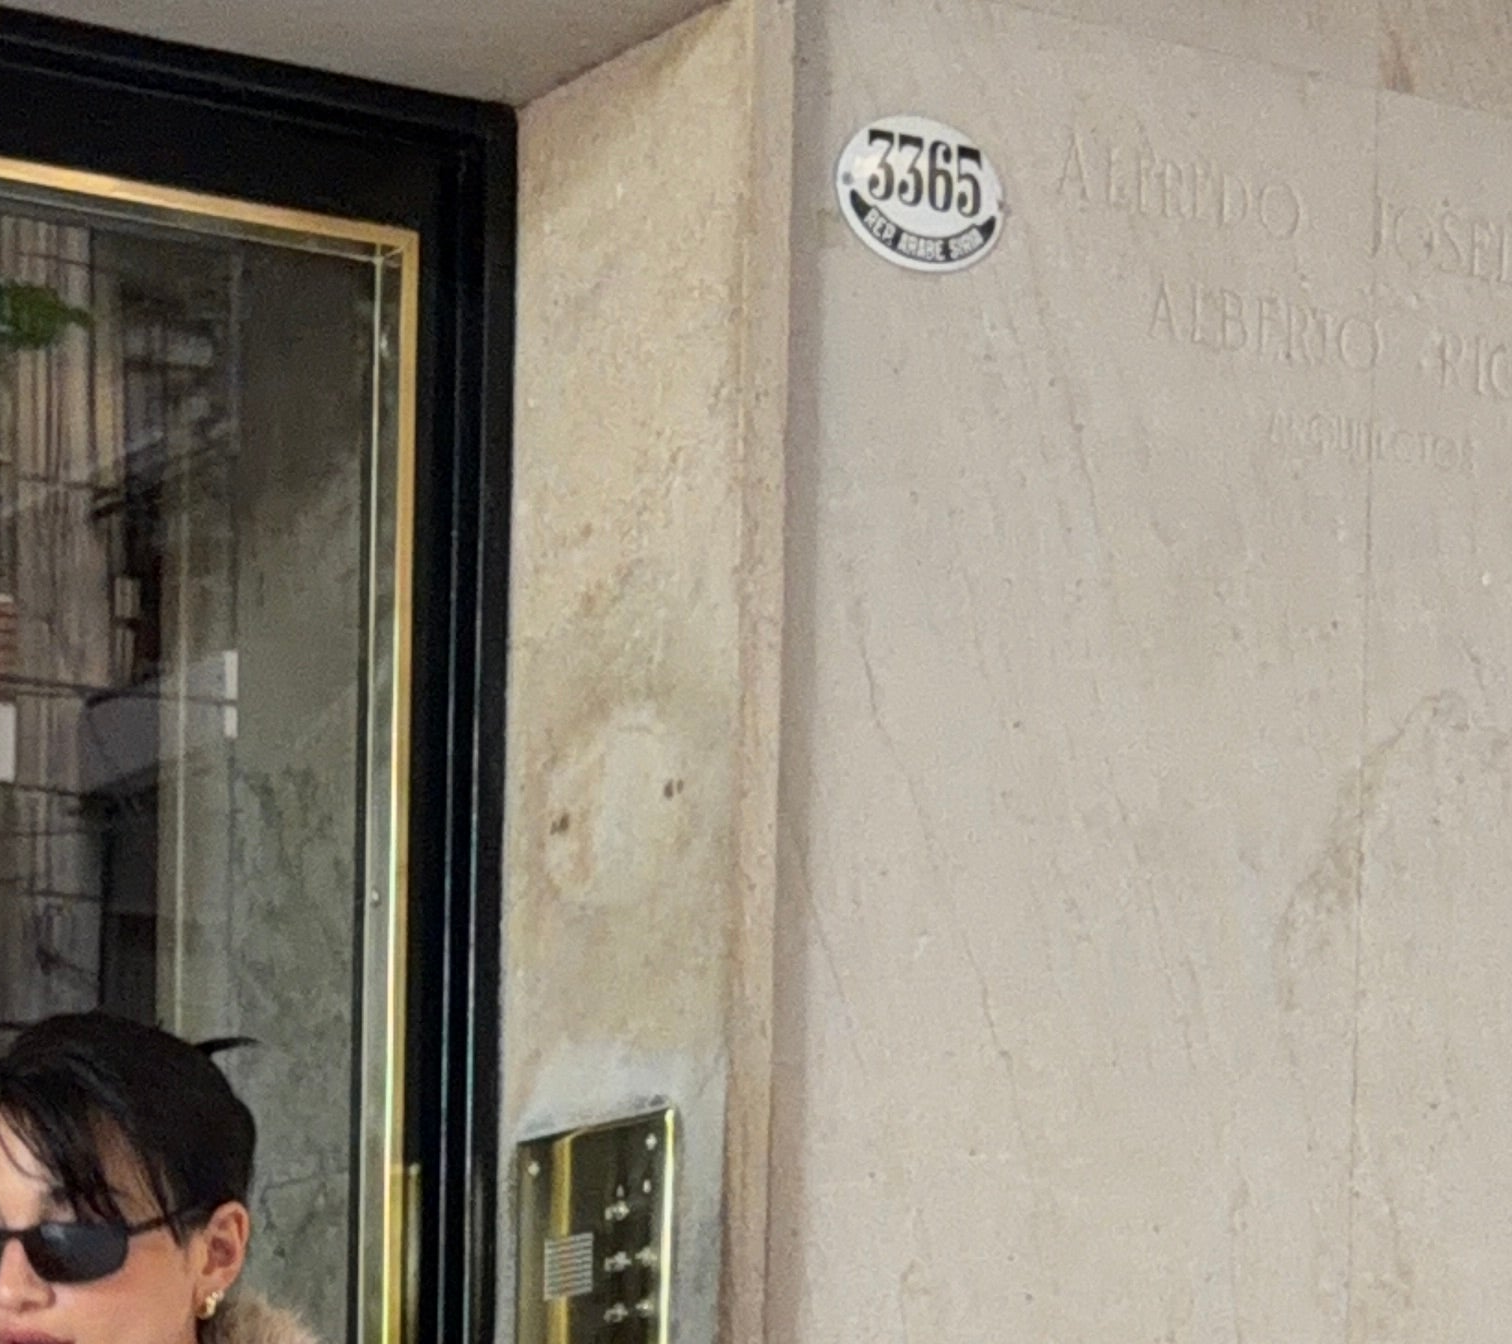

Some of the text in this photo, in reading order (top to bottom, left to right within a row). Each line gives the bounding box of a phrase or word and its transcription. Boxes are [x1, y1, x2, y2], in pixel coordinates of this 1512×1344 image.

[867, 128, 982, 218] 3365
[896, 231, 946, 262] ARABE
[1147, 274, 1386, 371] ALBERTO
